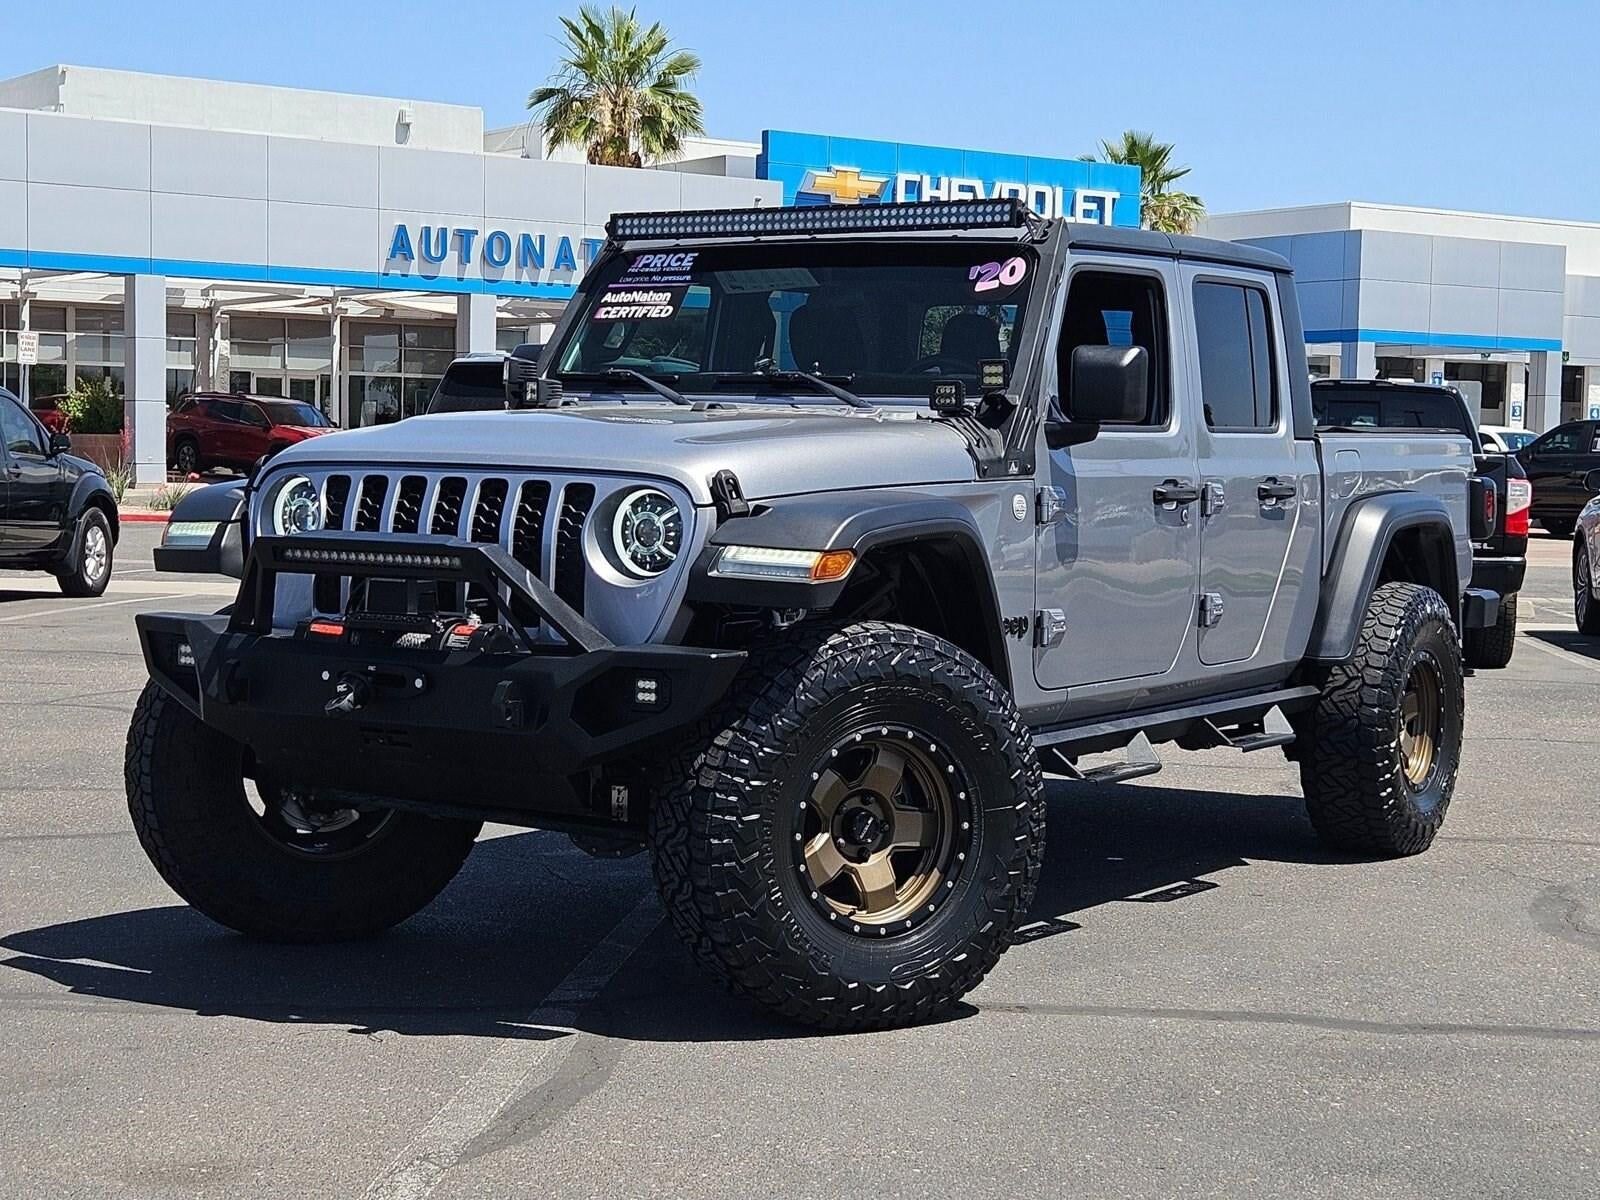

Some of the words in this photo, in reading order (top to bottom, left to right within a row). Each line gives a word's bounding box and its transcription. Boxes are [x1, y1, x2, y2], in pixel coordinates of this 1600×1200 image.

[896, 173, 1120, 226] CHEVROLET
[631, 253, 699, 268] 1PRICE
[600, 291, 671, 304] AutoNation
[598, 305, 673, 318] CERTIFIED
[1514, 406, 1521, 416] 3
